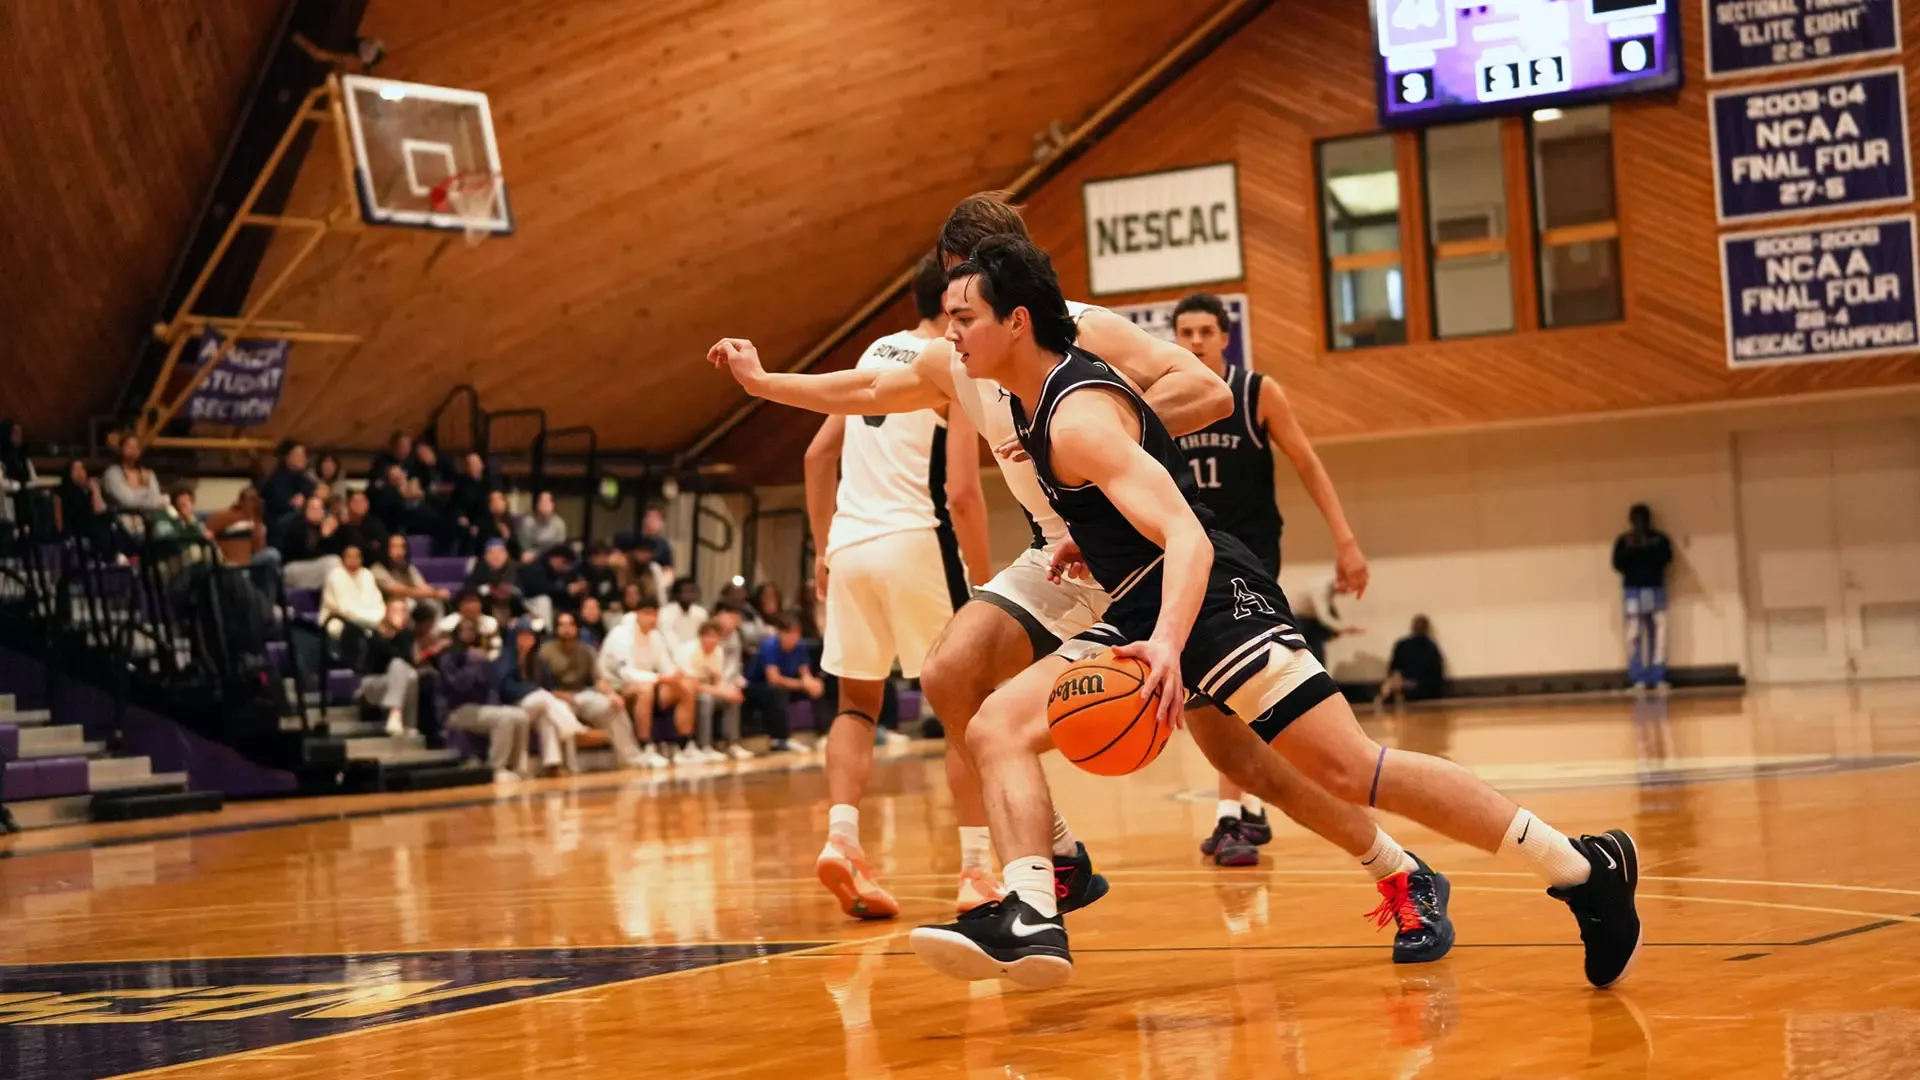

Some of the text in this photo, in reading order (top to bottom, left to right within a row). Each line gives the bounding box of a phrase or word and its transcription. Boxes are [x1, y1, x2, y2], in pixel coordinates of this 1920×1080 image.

[1621, 40, 1647, 72] 0
[1746, 82, 1867, 119] 2003-04
[1756, 111, 1860, 149] NCAA
[1731, 138, 1890, 184] FINAL FOUR
[1095, 201, 1230, 258] NESCAC
[1766, 248, 1871, 284] NCAA
[1741, 273, 1900, 315] FINAL FOUR
[1810, 321, 1915, 351] CHAMPIONS
[1188, 456, 1222, 488] 11
[1231, 577, 1276, 620] A
